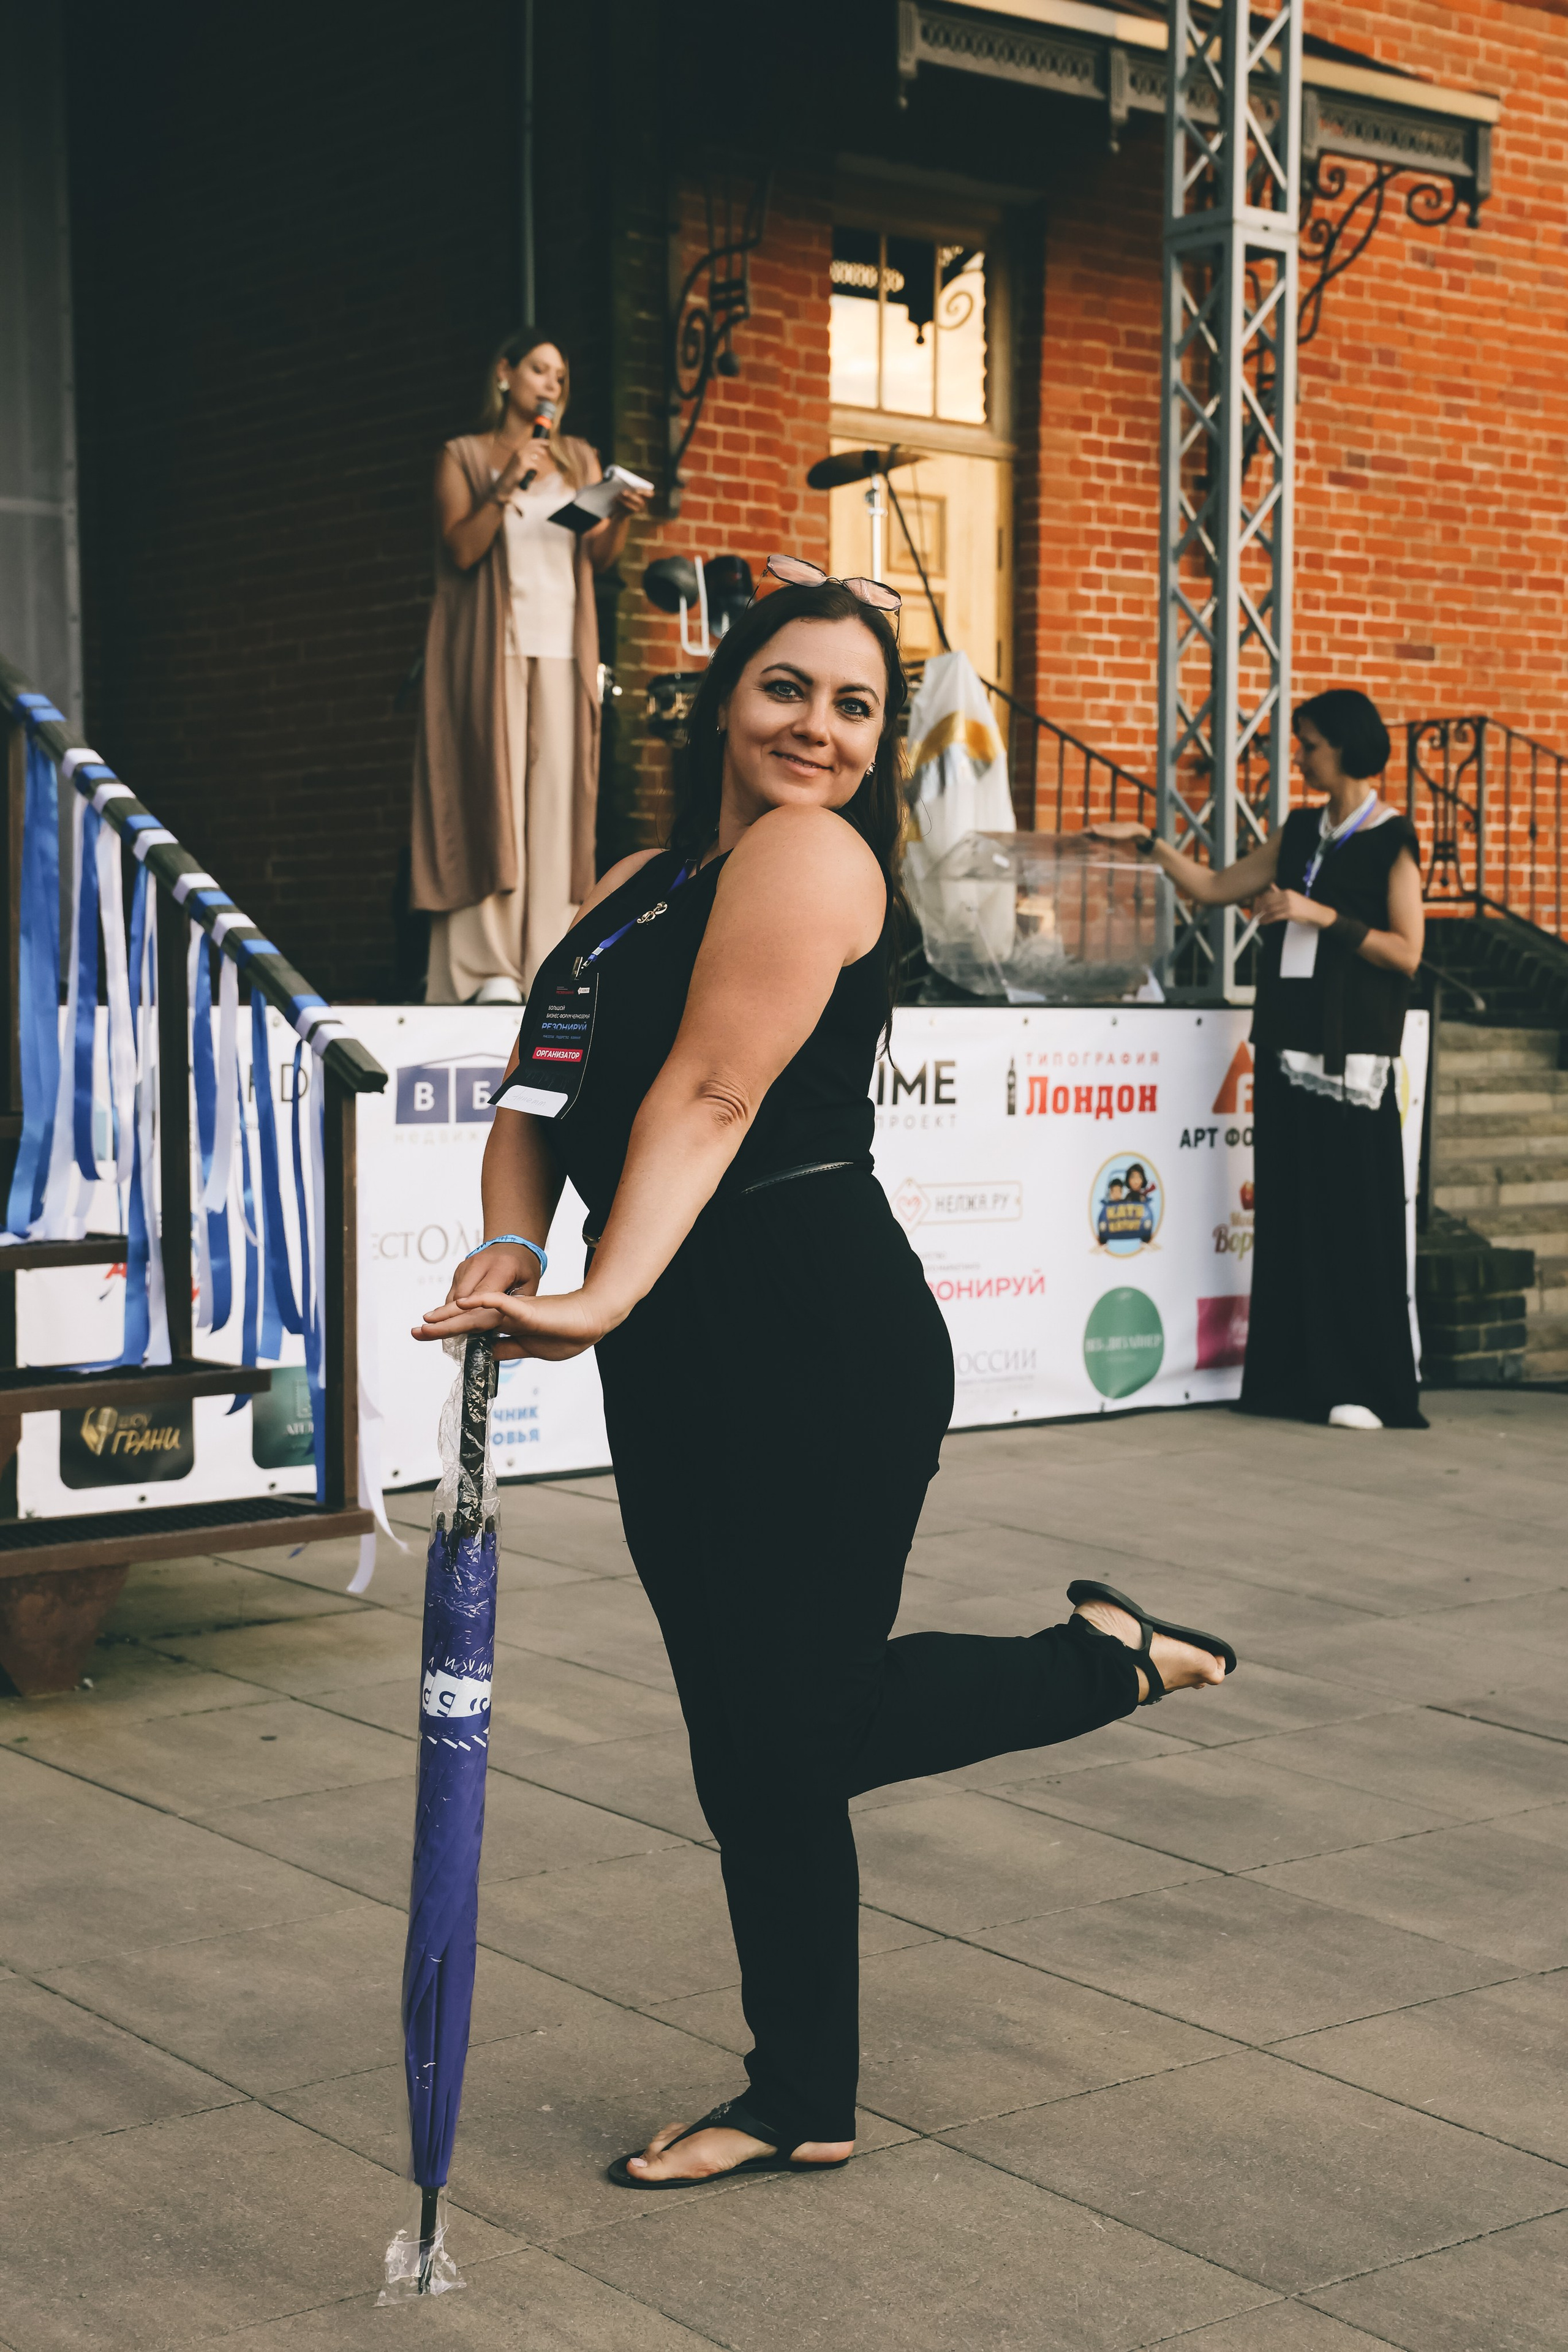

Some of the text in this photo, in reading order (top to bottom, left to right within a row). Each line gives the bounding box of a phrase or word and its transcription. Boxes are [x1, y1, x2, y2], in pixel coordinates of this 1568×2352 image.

[536, 1049, 580, 1060] ОРГАНИЗАТОР
[1025, 1051, 1159, 1066] ТИПОГРАФИЯ
[1026, 1076, 1157, 1120] Лондон
[1180, 1128, 1218, 1148] АРТ
[111, 1426, 181, 1456] ГРАНИ
[492, 1428, 540, 1446] ОВЬЯ
